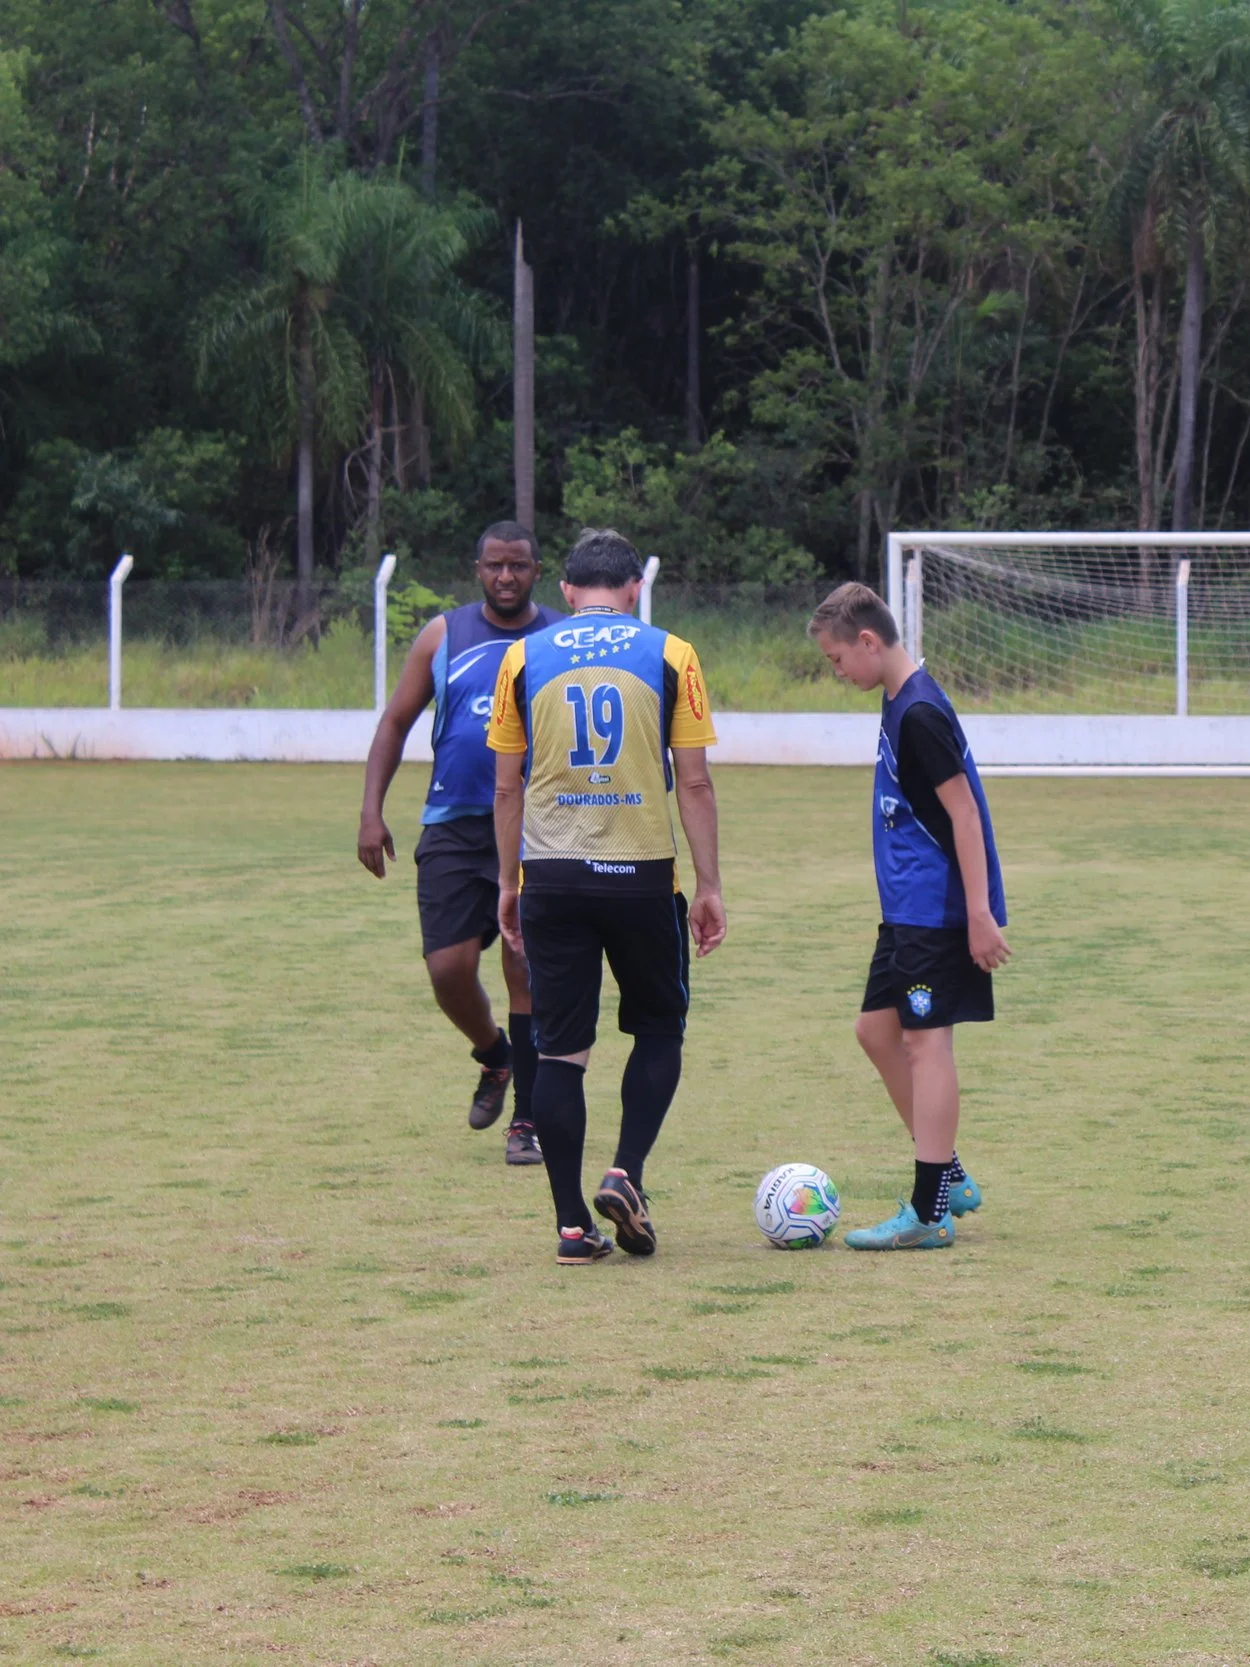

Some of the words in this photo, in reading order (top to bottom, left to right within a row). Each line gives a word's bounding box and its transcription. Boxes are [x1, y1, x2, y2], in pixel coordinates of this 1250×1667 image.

[554, 625, 640, 649] CEART
[565, 682, 624, 768] 19
[557, 793, 642, 806] DOURADOS-MS
[593, 862, 636, 874] Telecom
